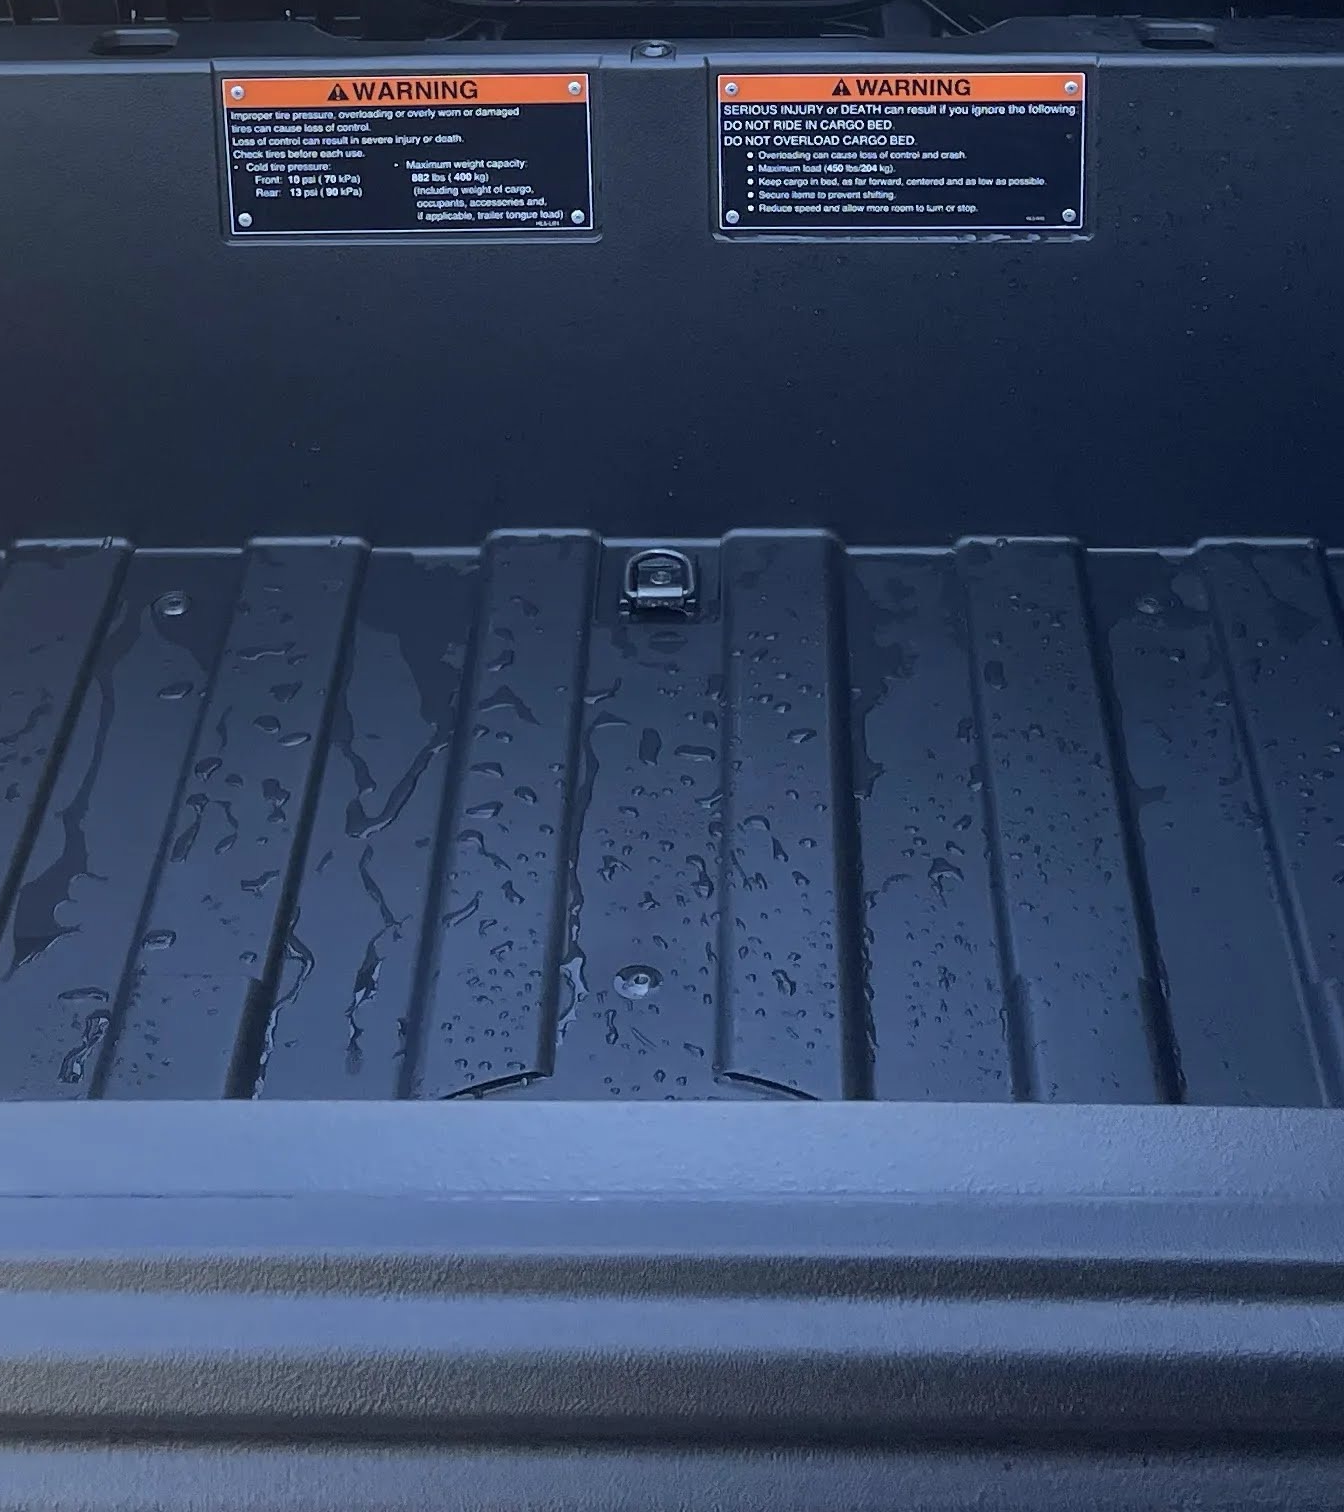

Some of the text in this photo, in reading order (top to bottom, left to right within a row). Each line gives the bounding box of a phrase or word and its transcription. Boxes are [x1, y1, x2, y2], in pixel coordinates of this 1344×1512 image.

[353, 80, 478, 100] WARNING
[856, 79, 971, 96] WARNING
[231, 111, 273, 121] Improper
[275, 111, 290, 119] tire
[292, 112, 336, 121] pressure,
[338, 110, 393, 120] overloading
[407, 109, 435, 119] overly
[438, 109, 461, 117] worn
[475, 107, 519, 118] damaged
[724, 105, 777, 115] SERIOUS
[781, 105, 824, 115] INJURY
[827, 106, 838, 114] or
[841, 104, 881, 114] DEATH
[884, 106, 904, 114] can
[907, 104, 936, 114] result
[940, 104, 946, 114] if
[948, 106, 969, 117] you
[971, 104, 1005, 116] ignore
[1008, 104, 1026, 114] the
[231, 123, 371, 133] tires can cause loss of control.
[724, 120, 742, 131] DO
[745, 120, 770, 130] NOT
[773, 120, 802, 130] RIDE
[805, 120, 817, 130] IN
[820, 120, 864, 130] CARGO
[232, 137, 255, 146] Loss
[257, 137, 267, 146] of
[269, 137, 301, 146] control
[302, 137, 320, 145] can
[322, 136, 348, 145] result
[350, 136, 359, 144] in
[395, 135, 420, 145] injury
[435, 134, 464, 143] death.
[724, 136, 742, 146] DO
[745, 135, 770, 146] NOT
[773, 135, 840, 146] OVERLOAD
[842, 135, 887, 146] CARGO
[233, 150, 263, 159] Check
[265, 150, 286, 158] tires
[288, 149, 318, 158] before
[320, 149, 343, 158] each
[758, 151, 811, 161] Overloading
[859, 151, 877, 159] loss
[879, 151, 888, 159] of
[890, 151, 920, 159] control
[922, 151, 939, 159] and
[941, 151, 967, 159] crash.
[246, 163, 332, 172] Cold tire pressure:
[406, 161, 451, 169] Maximum
[453, 160, 485, 169] weight
[758, 164, 800, 172] Maximum
[803, 164, 822, 172] load
[824, 164, 843, 173] (450
[879, 164, 896, 174] kg).
[255, 175, 283, 184] Front:
[288, 175, 300, 184] 10
[302, 175, 316, 185] psi
[338, 175, 360, 184] kPa)
[432, 173, 446, 182] lbs
[474, 172, 489, 182] kg)
[758, 178, 781, 187] Keep
[783, 179, 808, 187] cargo
[820, 178, 840, 186] bed,
[869, 178, 904, 186] forward,
[946, 177, 963, 185] and
[978, 177, 993, 185] low
[290, 188, 302, 197] 13
[304, 188, 318, 198] psi
[340, 187, 362, 197] kPa)
[461, 186, 491, 195] weight
[493, 185, 503, 193] of
[758, 191, 896, 200] Secure items to prevent shifting.
[417, 199, 467, 208] occupants,
[469, 198, 524, 207] accessories
[794, 204, 822, 213] speed
[824, 204, 840, 212] and
[842, 204, 864, 212] allow
[915, 204, 924, 212] to
[926, 204, 944, 212] turn
[957, 204, 978, 213] stop.
[425, 212, 475, 222] applicable,
[477, 211, 504, 220] trailer
[506, 211, 538, 220] tongue
[539, 209, 563, 220] load)
